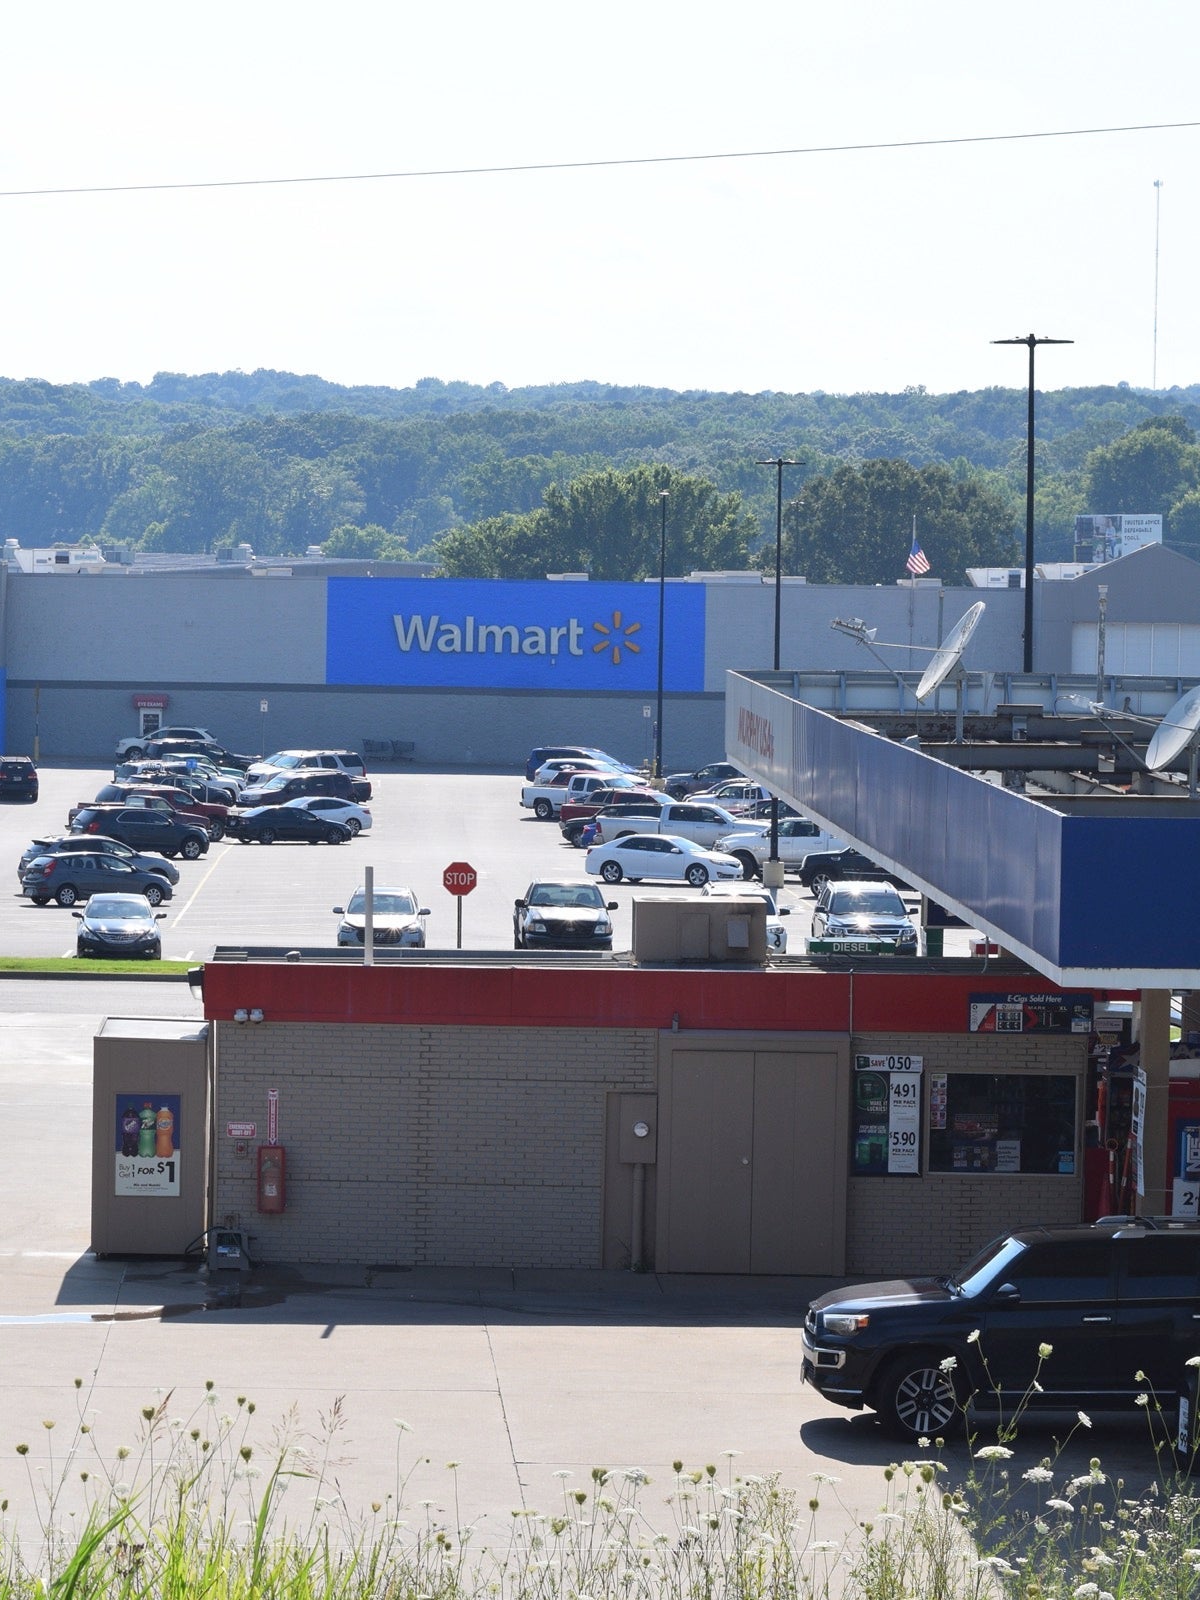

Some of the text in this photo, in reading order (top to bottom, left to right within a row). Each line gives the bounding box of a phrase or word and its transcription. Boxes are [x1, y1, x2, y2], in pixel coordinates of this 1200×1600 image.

[393, 614, 584, 656] Walmart
[445, 872, 475, 885] STOP
[833, 942, 872, 952] DIESEL
[1008, 995, 1028, 1003] E-Cigs
[890, 1084, 916, 1098] $4.91
[889, 1132, 916, 1146] $5.90
[157, 1161, 175, 1182] $1
